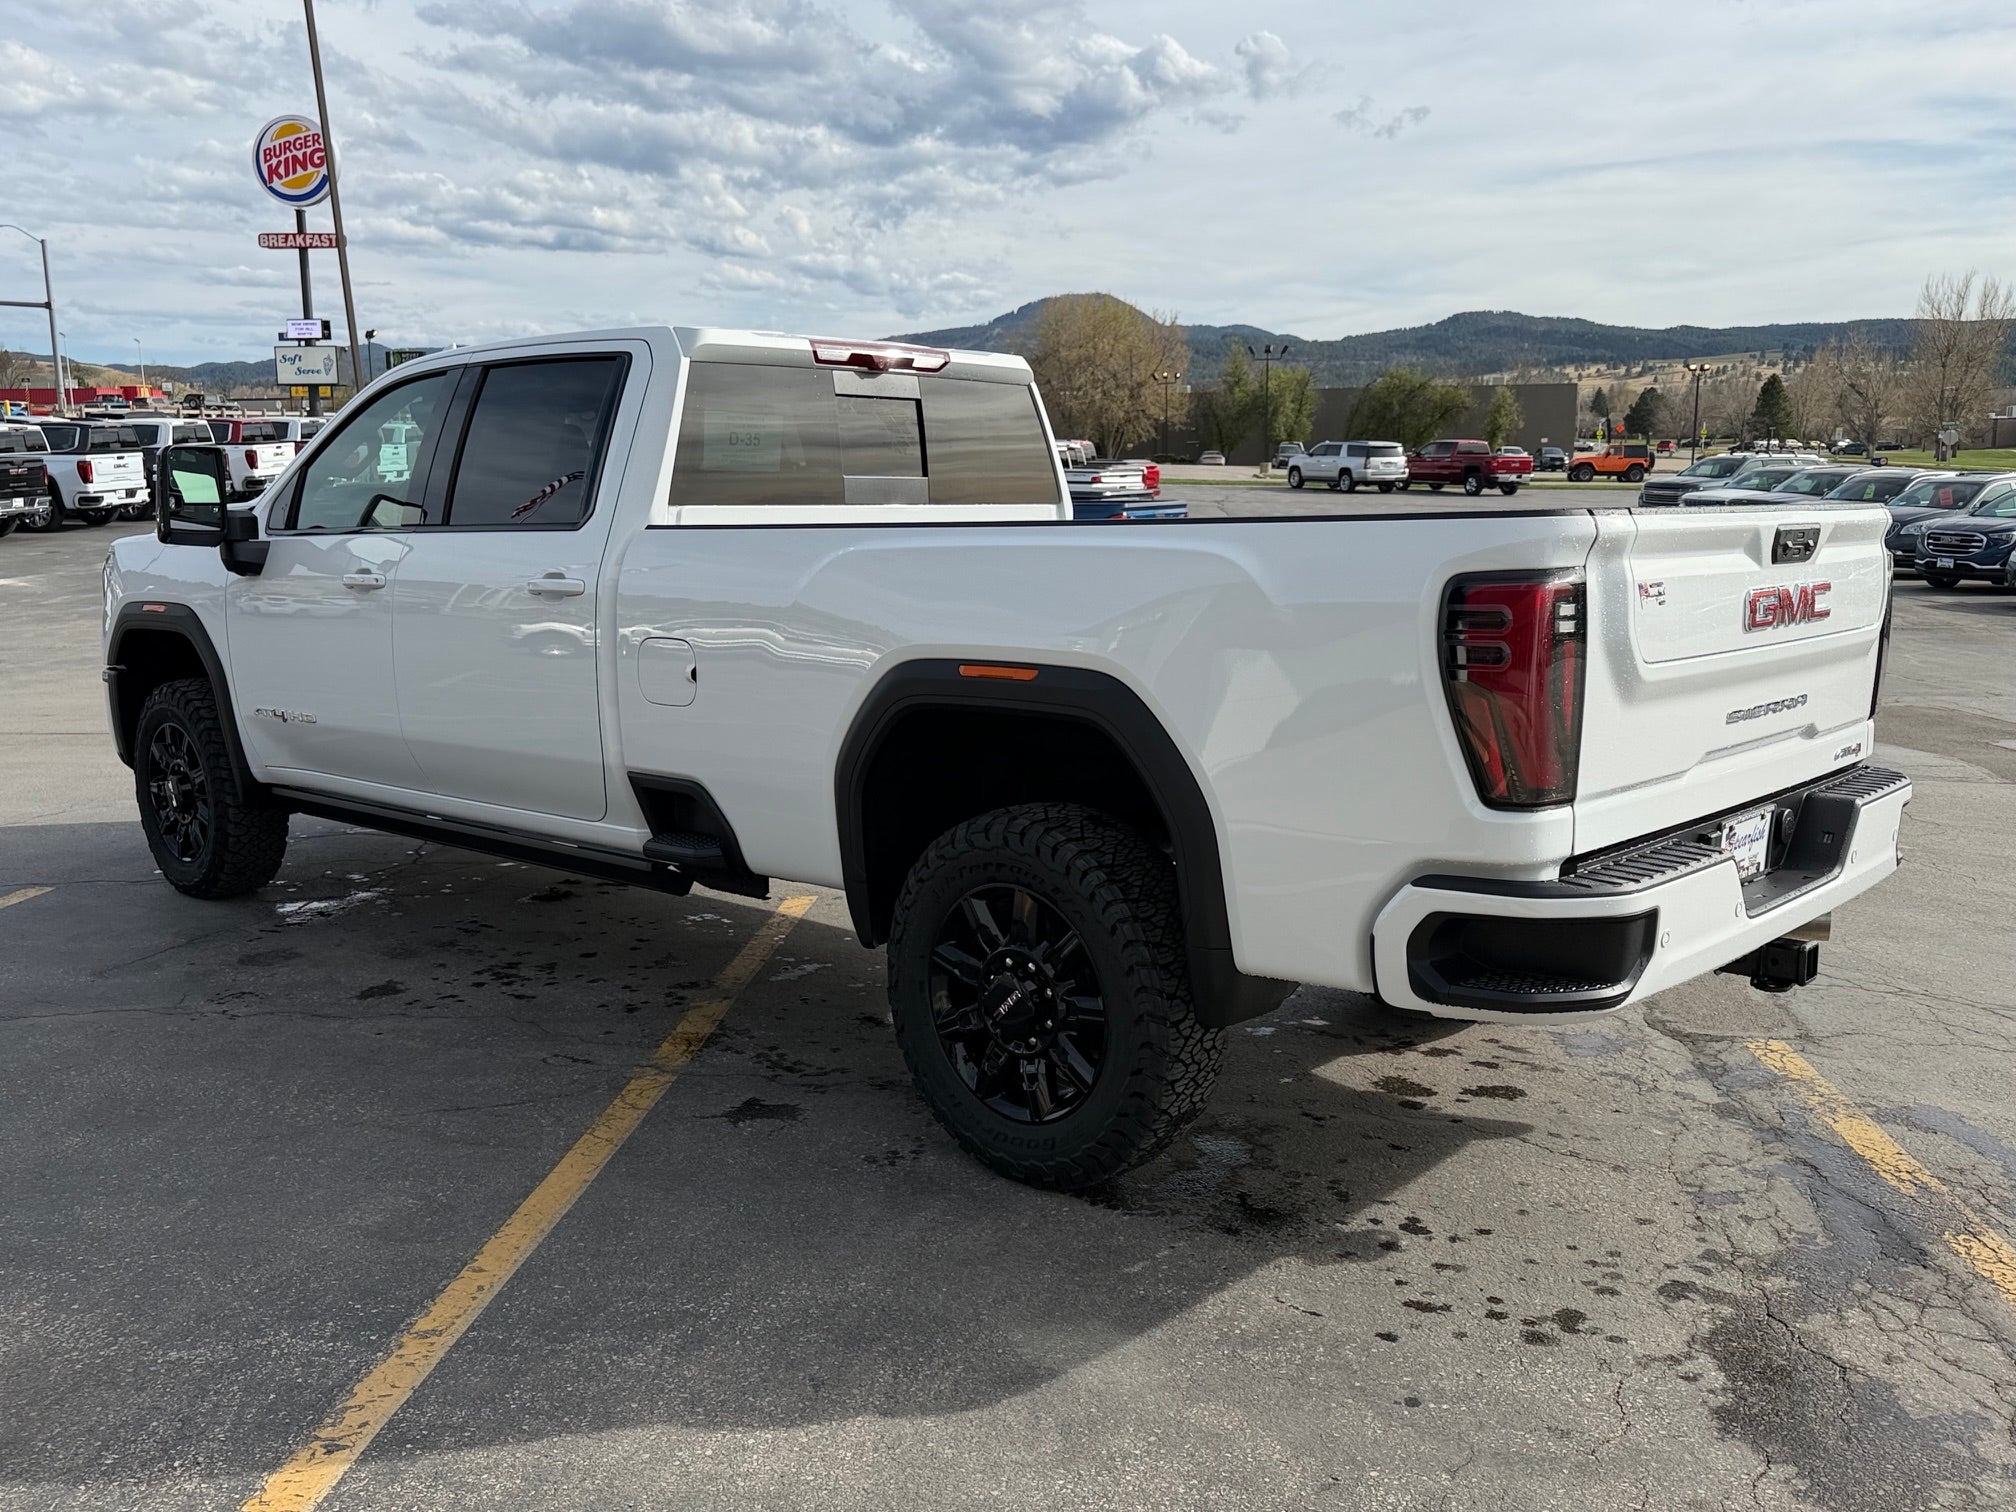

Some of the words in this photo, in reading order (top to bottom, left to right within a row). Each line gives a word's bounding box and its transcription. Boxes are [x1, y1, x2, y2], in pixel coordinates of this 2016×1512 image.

[263, 132, 322, 164] BURGER
[266, 147, 326, 185] KING
[260, 234, 337, 248] BREAKFAST
[279, 354, 302, 365] Soft
[295, 367, 322, 376] Serve
[729, 431, 760, 448] D-35
[1744, 579, 1832, 633] GMC
[1726, 693, 1808, 725] SIERRA
